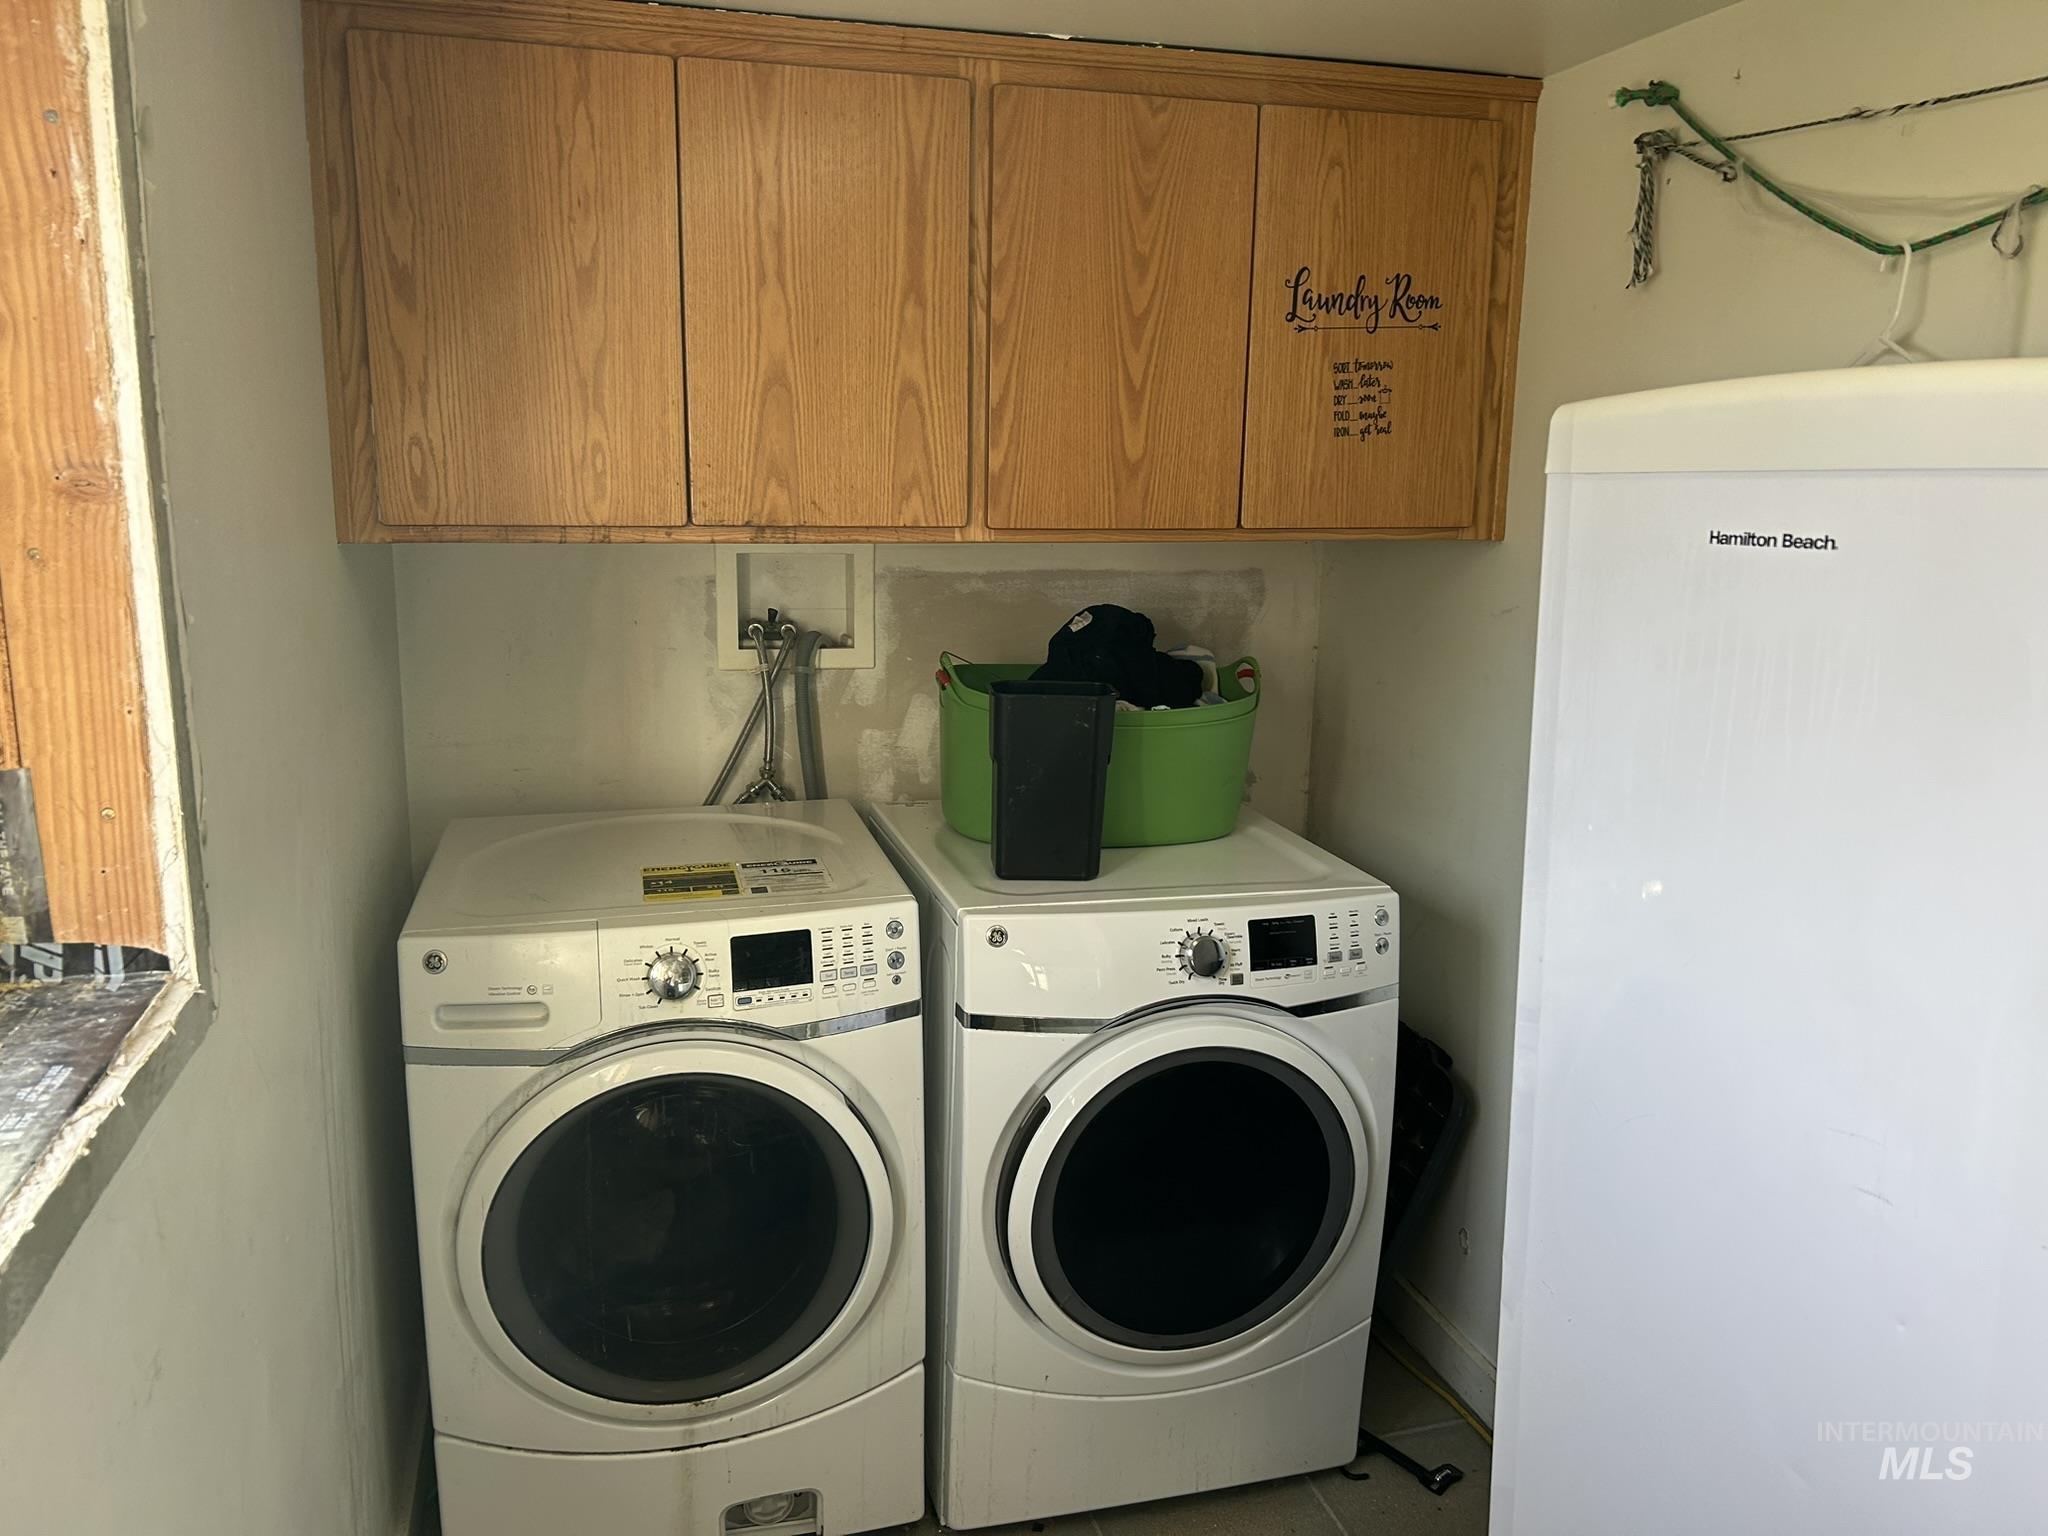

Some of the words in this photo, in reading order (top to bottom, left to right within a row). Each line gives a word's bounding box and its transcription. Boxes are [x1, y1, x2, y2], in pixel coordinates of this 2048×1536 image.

[1284, 266, 1387, 334] Laundry
[1385, 273, 1443, 323] Room
[1333, 361, 1350, 374] SORT
[1353, 358, 1393, 373] tomorrow
[1333, 379, 1353, 390] WASH
[1358, 373, 1381, 388] later
[1333, 394, 1346, 406] DRY
[1333, 409, 1350, 421] FOLD
[1359, 405, 1387, 425] maybe
[1333, 426, 1350, 437] IRON
[1359, 423, 1372, 442] get
[1375, 420, 1392, 435] real
[1709, 530, 1777, 548] Hamilton
[1782, 533, 1836, 550] Beach
